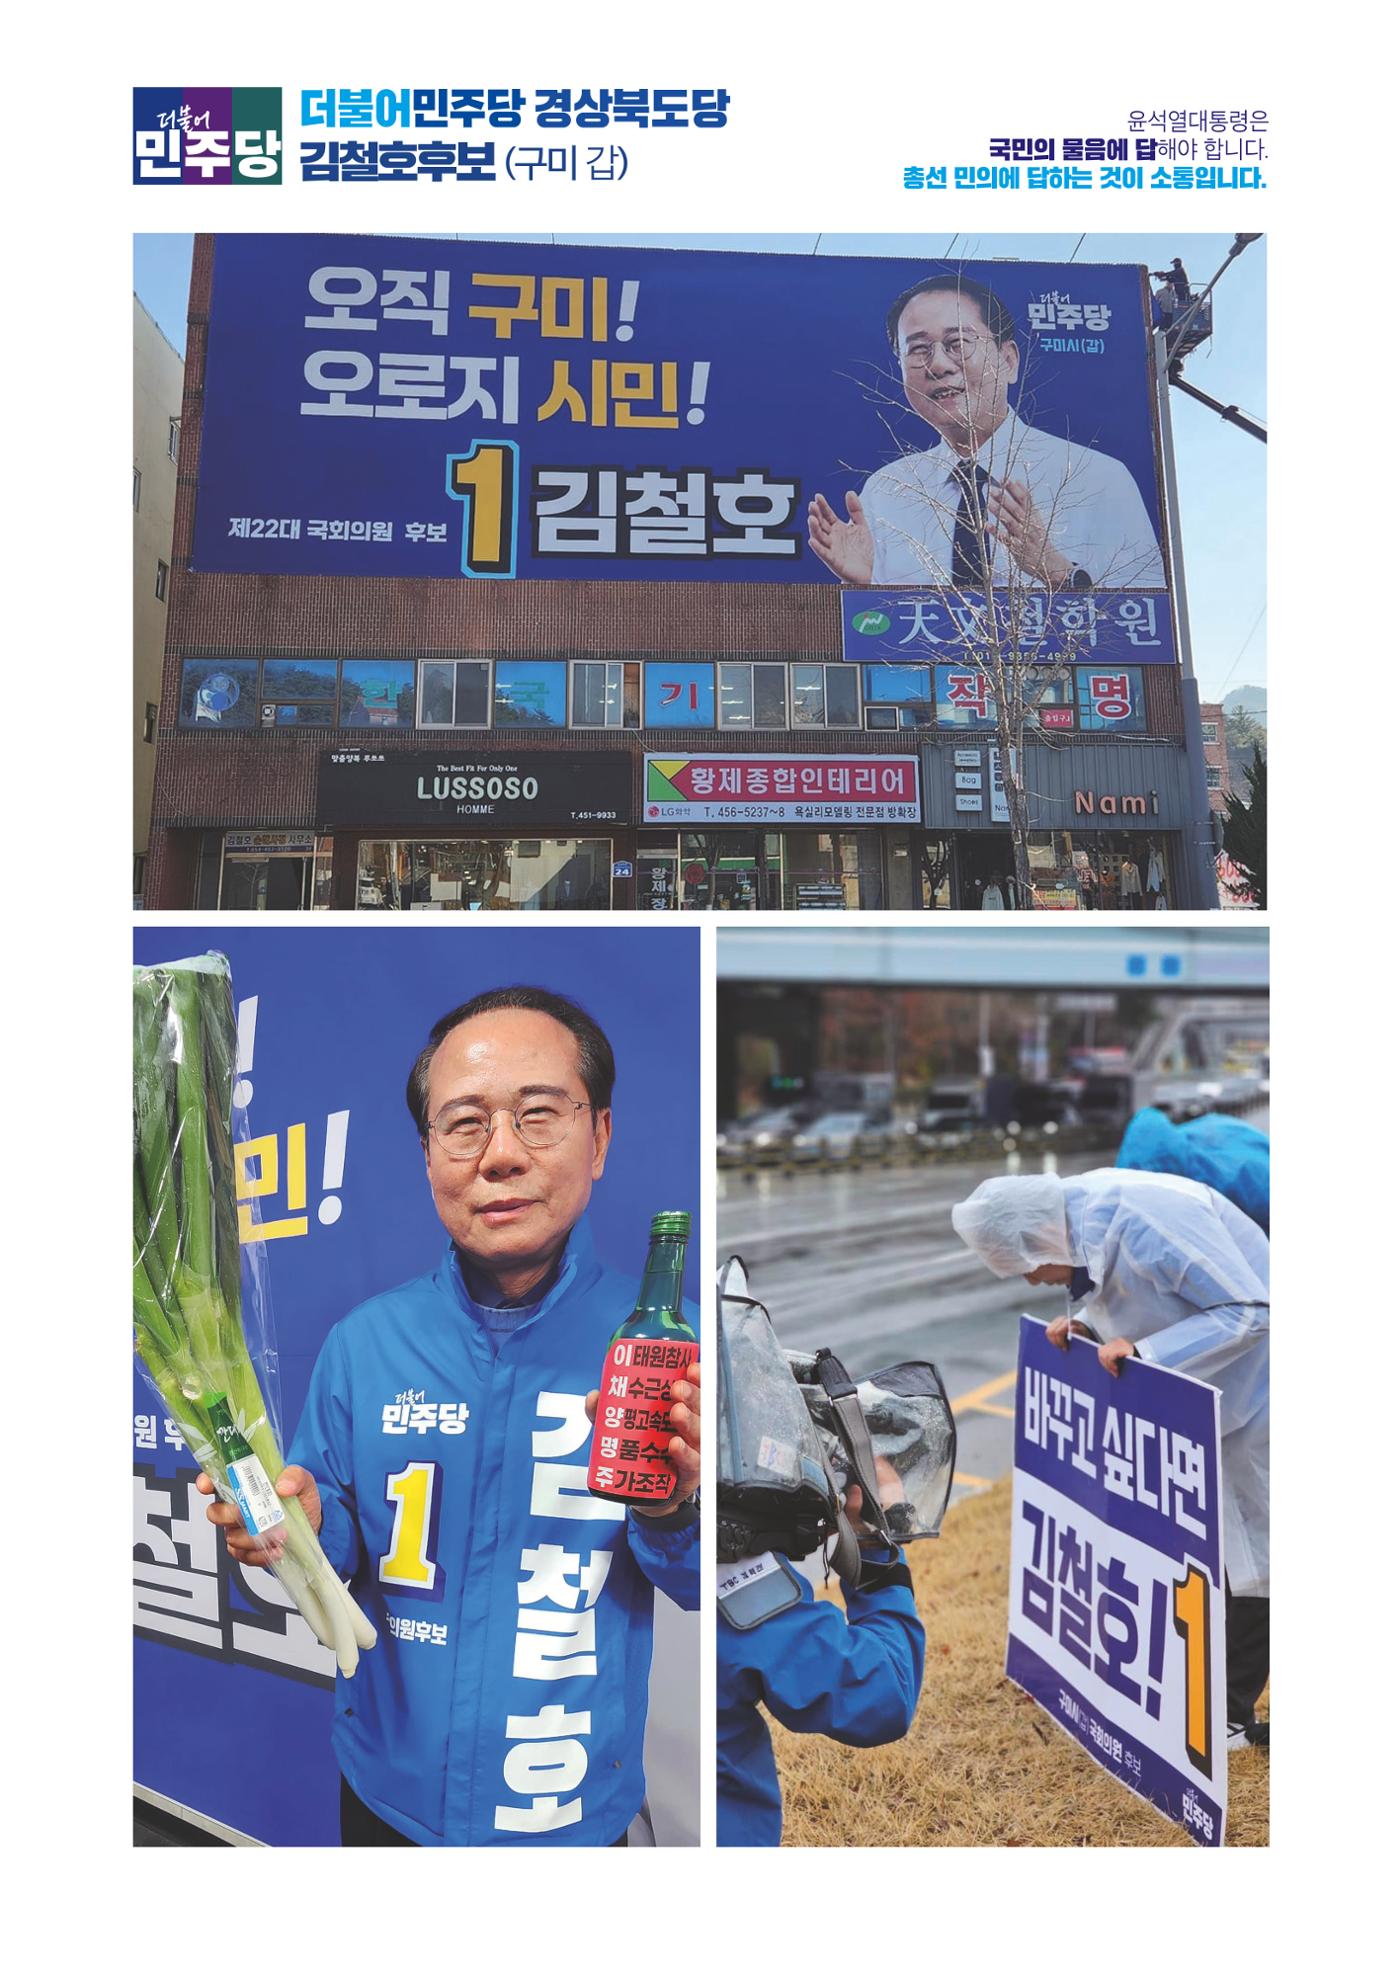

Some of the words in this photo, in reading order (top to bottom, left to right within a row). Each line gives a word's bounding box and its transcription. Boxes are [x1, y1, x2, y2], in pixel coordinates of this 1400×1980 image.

[304, 266, 450, 336] 오직
[468, 272, 641, 342] 구미!
[1040, 290, 1071, 304] 더불어
[1027, 303, 1112, 331] 민주당
[1040, 338, 1105, 354] 구미시(갑)
[300, 349, 519, 424] 오로지
[537, 359, 711, 429] 시민!
[452, 443, 511, 571] 1
[537, 468, 797, 556] 김철호
[228, 516, 301, 541] 제22대
[306, 518, 393, 543] 국회의원
[404, 521, 447, 543] 후보
[1090, 672, 1132, 720] 명
[489, 765, 503, 773] Only
[691, 767, 905, 795] 황제종합인테리어
[417, 776, 538, 800] LUSSOSO
[456, 804, 495, 814] HOMME
[794, 806, 852, 819] 욕실리모델링
[856, 806, 884, 818] 전문점
[1074, 790, 1160, 815] Nami
[615, 868, 629, 876] 24
[613, 1344, 692, 1369] 이태원참사
[395, 1388, 425, 1406] 더불어
[382, 1403, 470, 1434] 민주당
[1024, 1366, 1097, 1480] 바꾸고
[1102, 1406, 1207, 1541] 싶다면
[595, 1466, 672, 1494] 주가조작
[379, 1461, 441, 1593] 1
[1021, 1500, 1168, 1722] 김철호!
[386, 1612, 448, 1646] 의원후보
[1173, 1565, 1213, 1778] 1
[1089, 1718, 1122, 1764] 국회의원
[1124, 1750, 1142, 1777] 후보
[1182, 1793, 1214, 1841] 민주당
